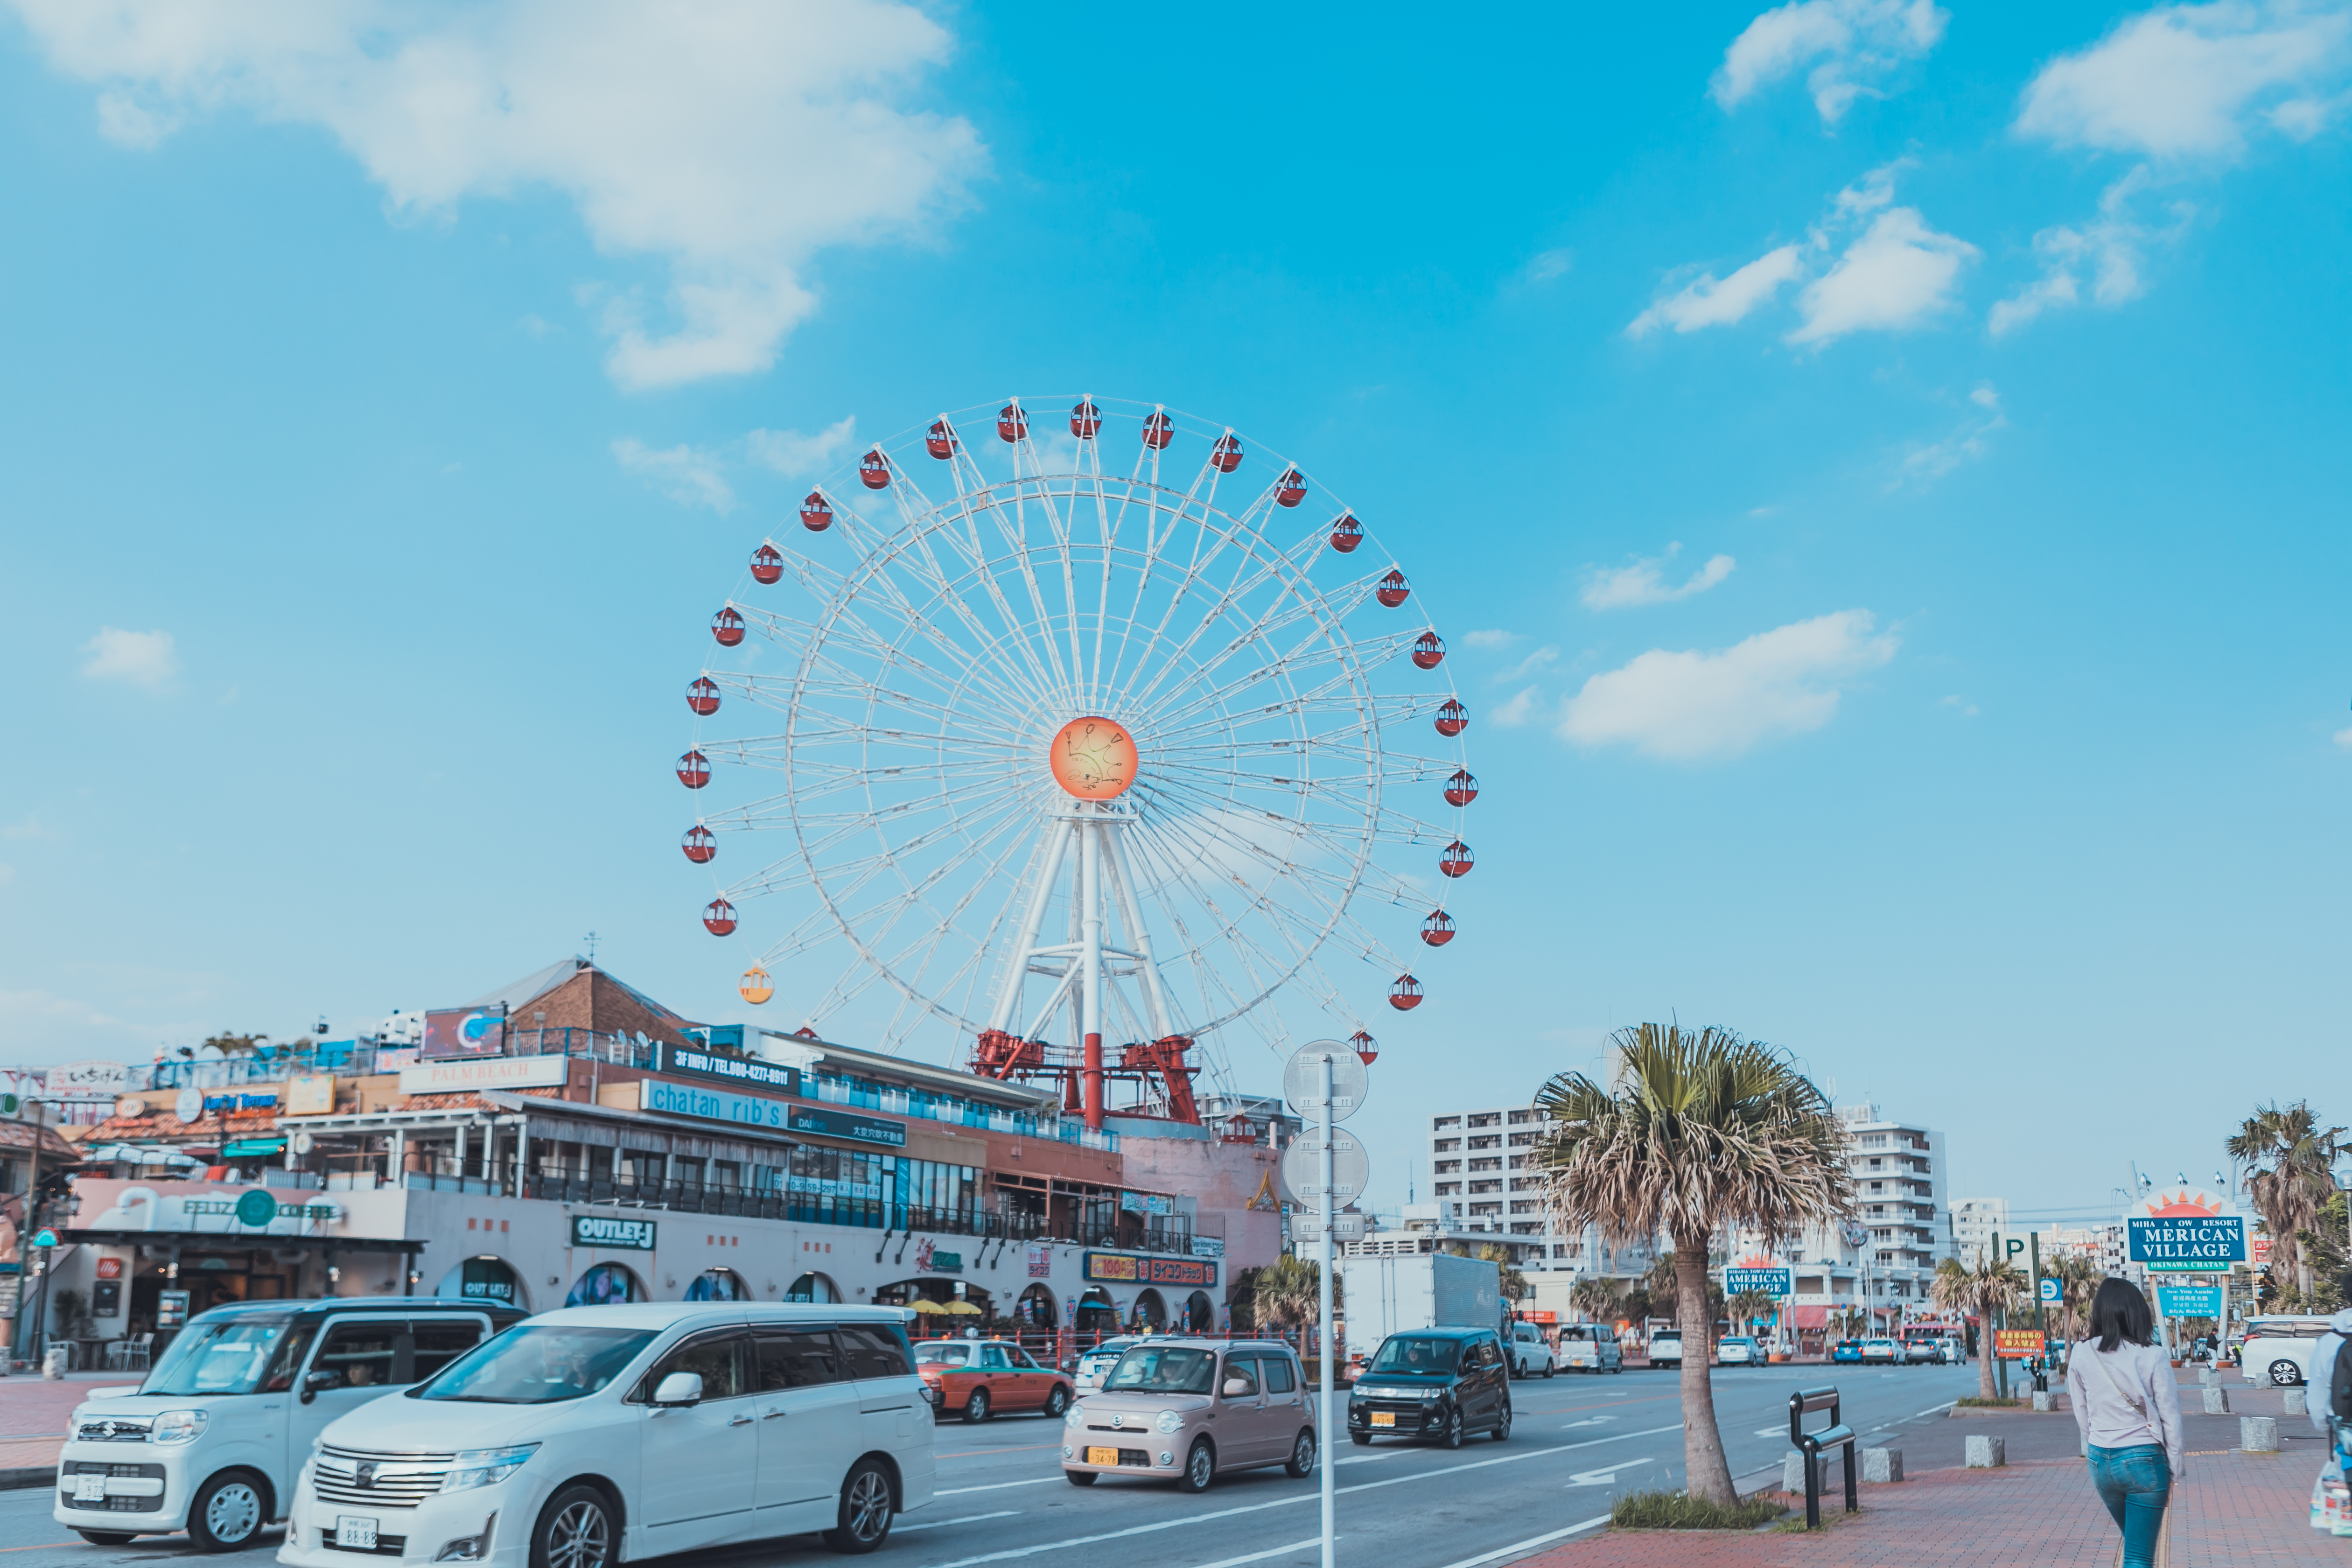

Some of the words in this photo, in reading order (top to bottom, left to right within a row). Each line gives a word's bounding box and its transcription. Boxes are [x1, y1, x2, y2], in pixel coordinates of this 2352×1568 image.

[687, 1052, 708, 1071] INFO
[431, 1067, 473, 1083] PALM
[478, 1063, 529, 1079] BEACH
[654, 1084, 720, 1118] chatan
[733, 1098, 780, 1126] rib's
[184, 1200, 231, 1214] FELIZ
[578, 1218, 653, 1249] OUTLET-J
[2006, 1239, 2024, 1260] P
[2142, 1243, 2231, 1258] VILLAGE
[1154, 1262, 1182, 1280] ダイコク
[1729, 1274, 1786, 1283] AMERICAN
[1095, 1454, 1116, 1464] 34-78
[347, 1529, 377, 1545] 88-88
